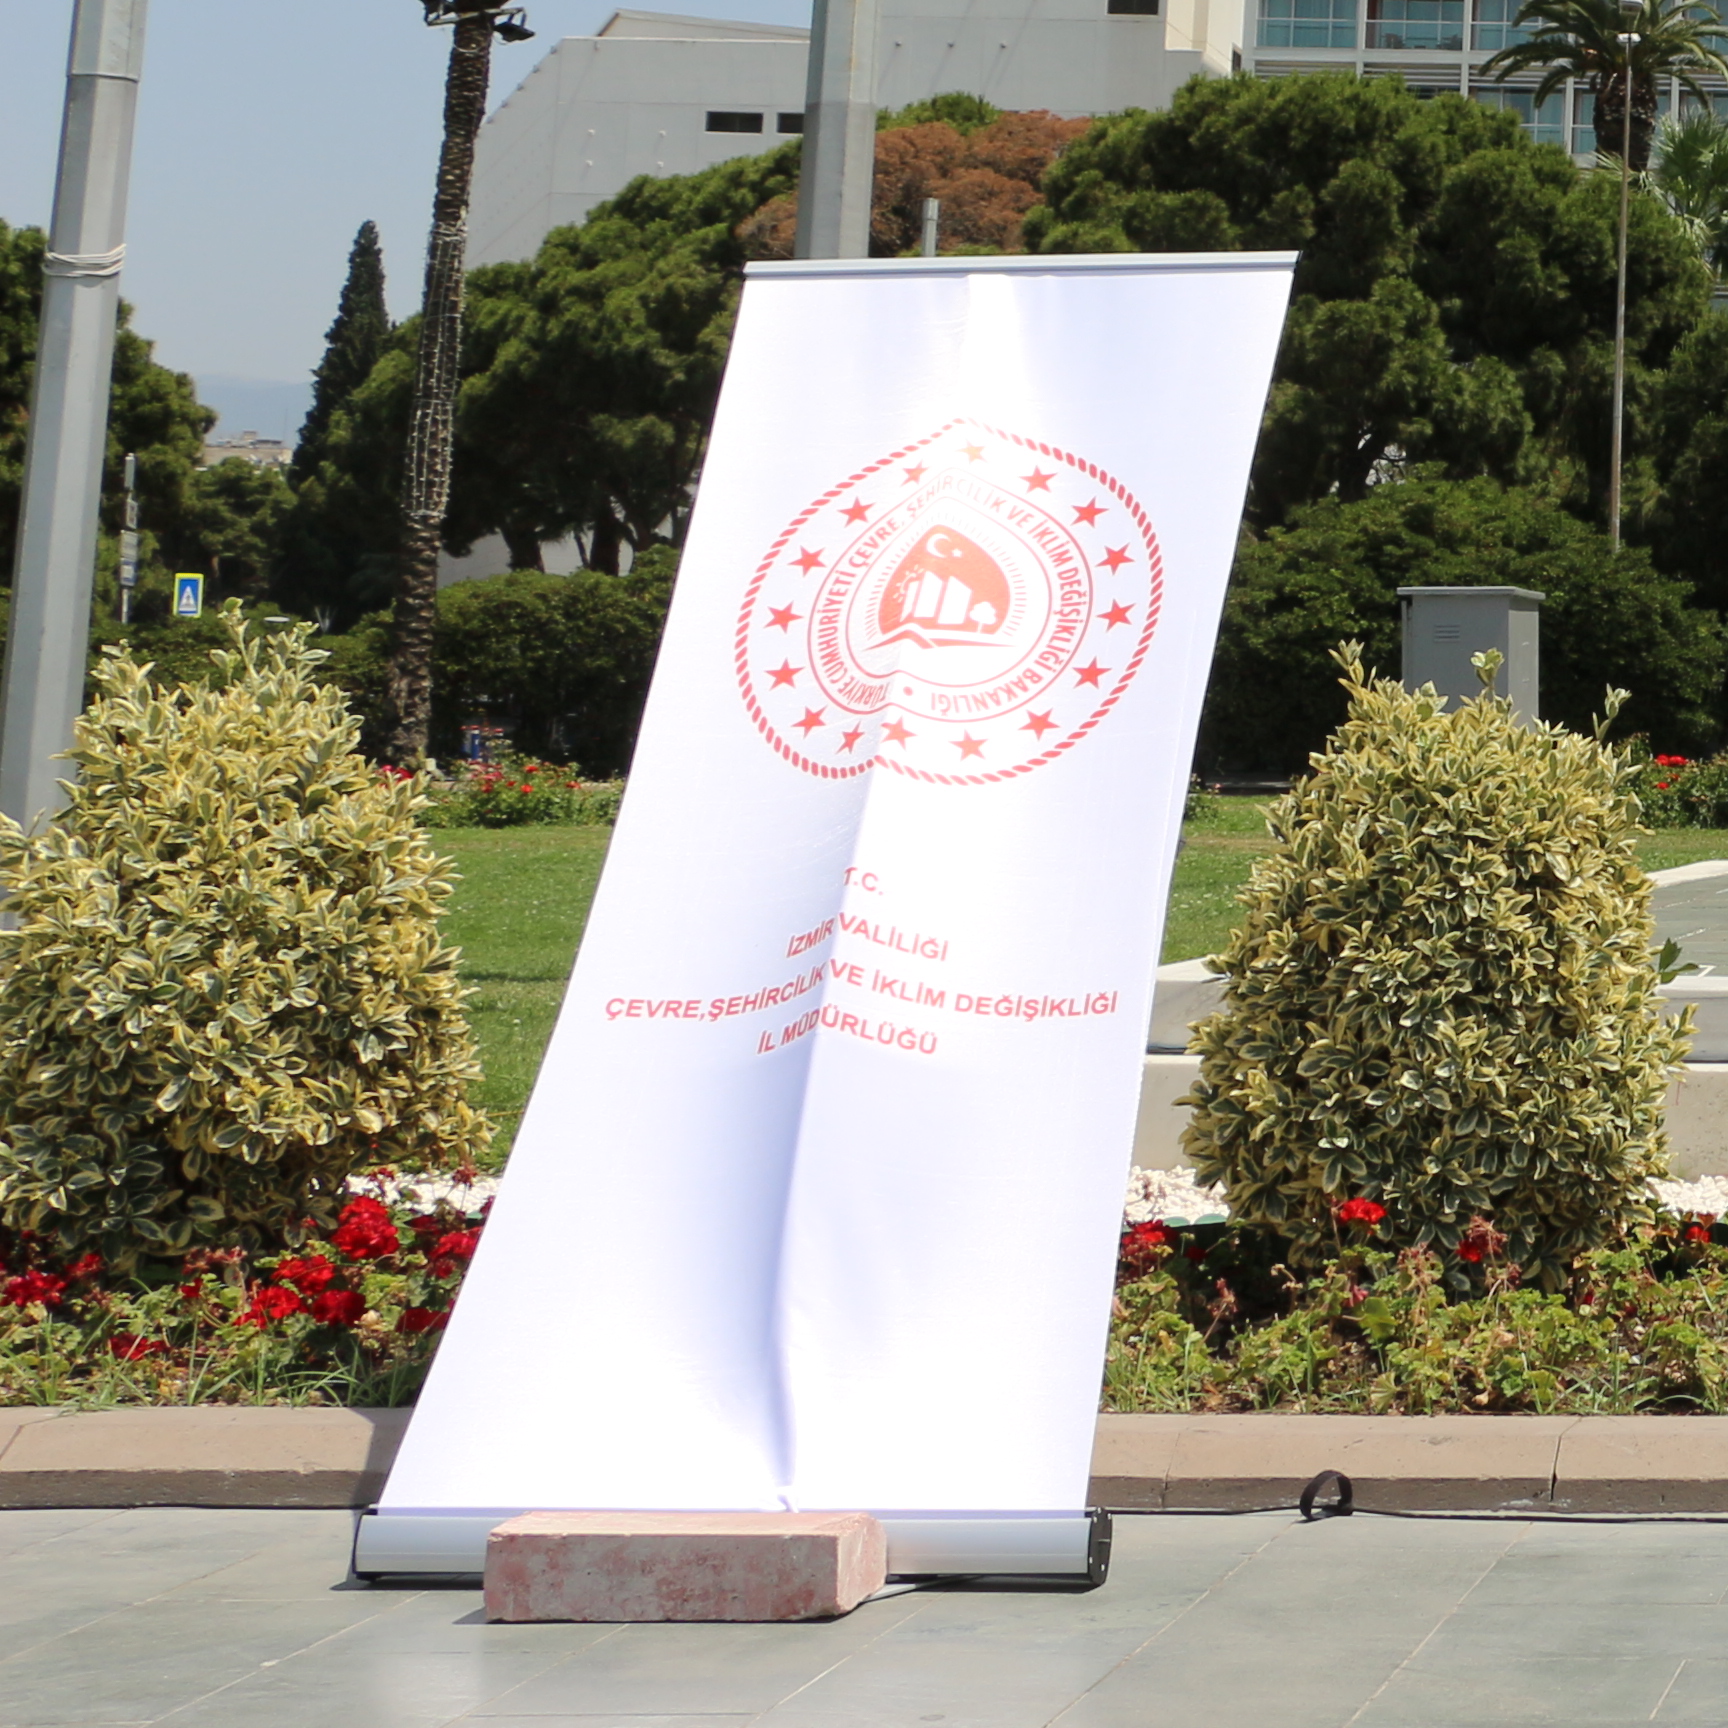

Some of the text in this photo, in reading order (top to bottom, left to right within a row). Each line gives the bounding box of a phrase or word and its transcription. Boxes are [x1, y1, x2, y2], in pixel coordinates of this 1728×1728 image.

[1006, 504, 1034, 529] VE
[1027, 518, 1075, 571] İKLİM
[817, 569, 857, 685] CUMHURİYETİ
[930, 667, 1045, 718] BAKANLIĞI
[843, 866, 885, 897] T.C.
[786, 911, 950, 963] İZMİR VALİLİĞİ
[604, 958, 1120, 1024] ÇEVRE,ŞEHİRCİLİK VE İKLİM DEĞİŞİKLİĞİ
[756, 1003, 939, 1056] İL MÜDÜRLÜĞÜ
